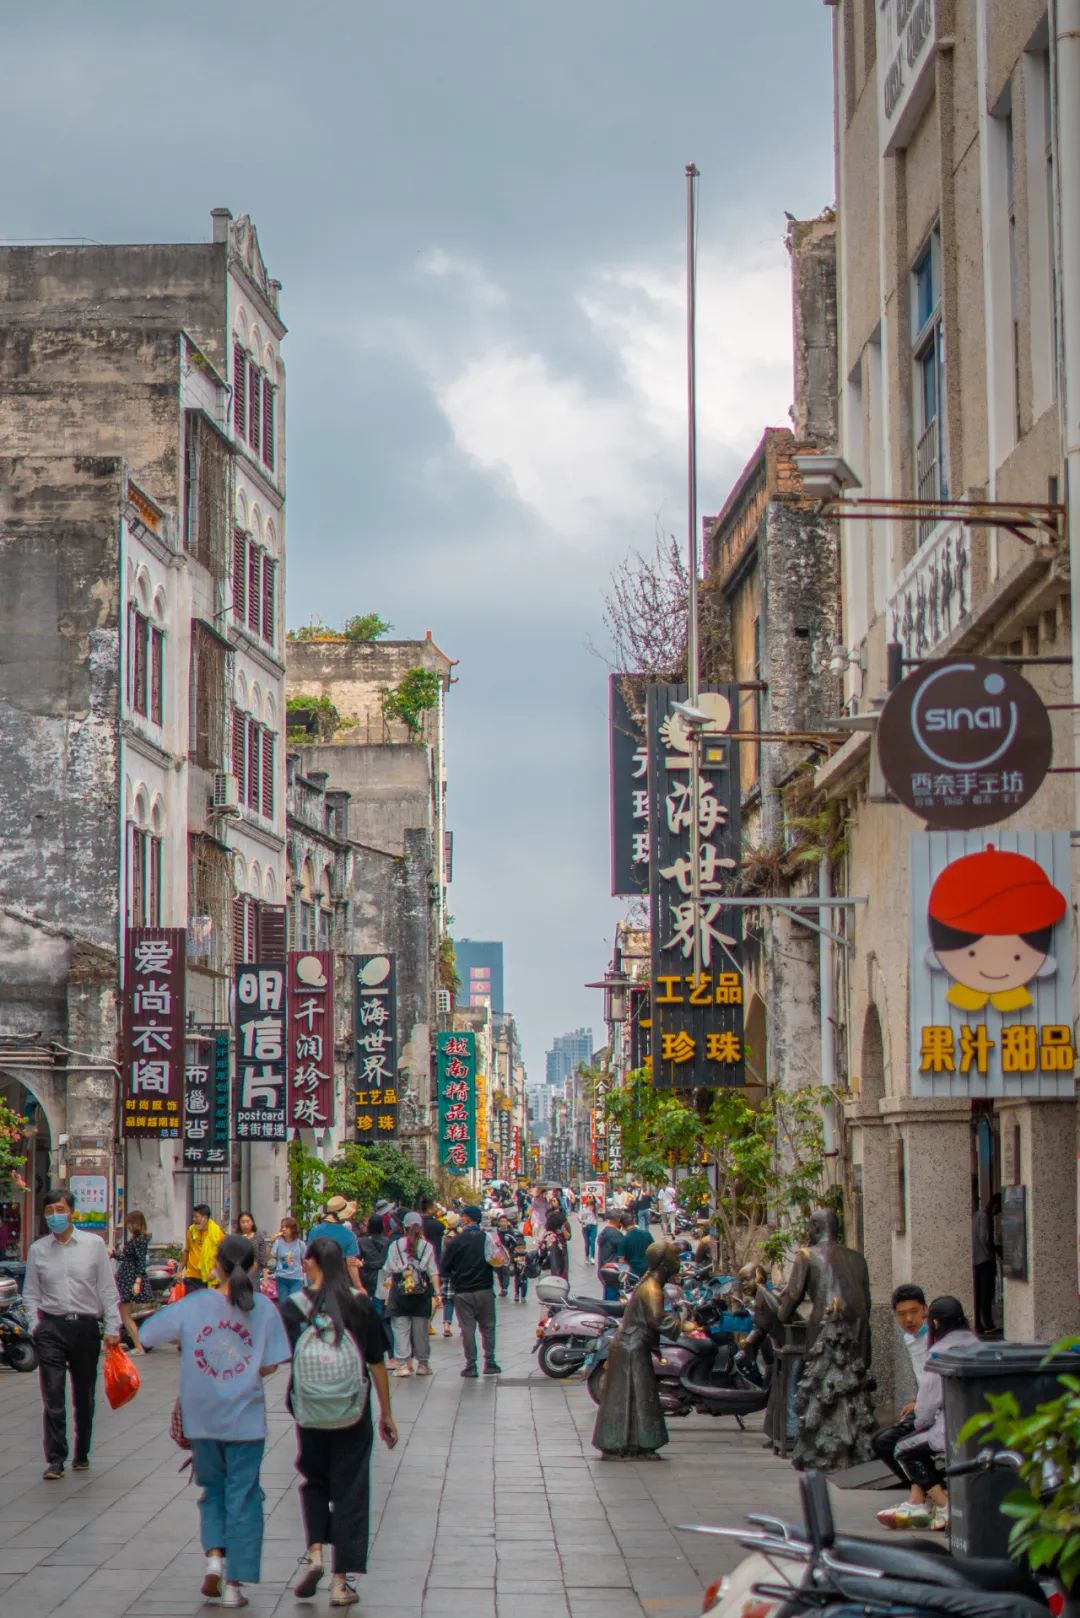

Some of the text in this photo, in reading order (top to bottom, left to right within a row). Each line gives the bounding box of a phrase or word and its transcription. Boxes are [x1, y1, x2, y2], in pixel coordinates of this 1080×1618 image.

[925, 706, 1002, 731] sinai
[659, 781, 737, 968] 海世界
[655, 973, 743, 1005] 工艺品
[132, 940, 173, 1095] 爱尚衣阁
[238, 970, 283, 1109] 明信片
[357, 998, 394, 1087] 海世界
[662, 1032, 742, 1063] 珍珠
[920, 1025, 1075, 1073] 果汁甜品
[293, 999, 331, 1126] 千润珍珠
[126, 1099, 178, 1111] 时尚服饰
[356, 1088, 397, 1106] 工艺品
[443, 1038, 472, 1165] 越南精品鞋店
[238, 1109, 284, 1122] postcard
[356, 1115, 395, 1132] 珍珠
[184, 1147, 225, 1161] 布艺
[196, 1326, 212, 1343] TO
[218, 1320, 253, 1347] MEET
[222, 1354, 253, 1381] YOU
